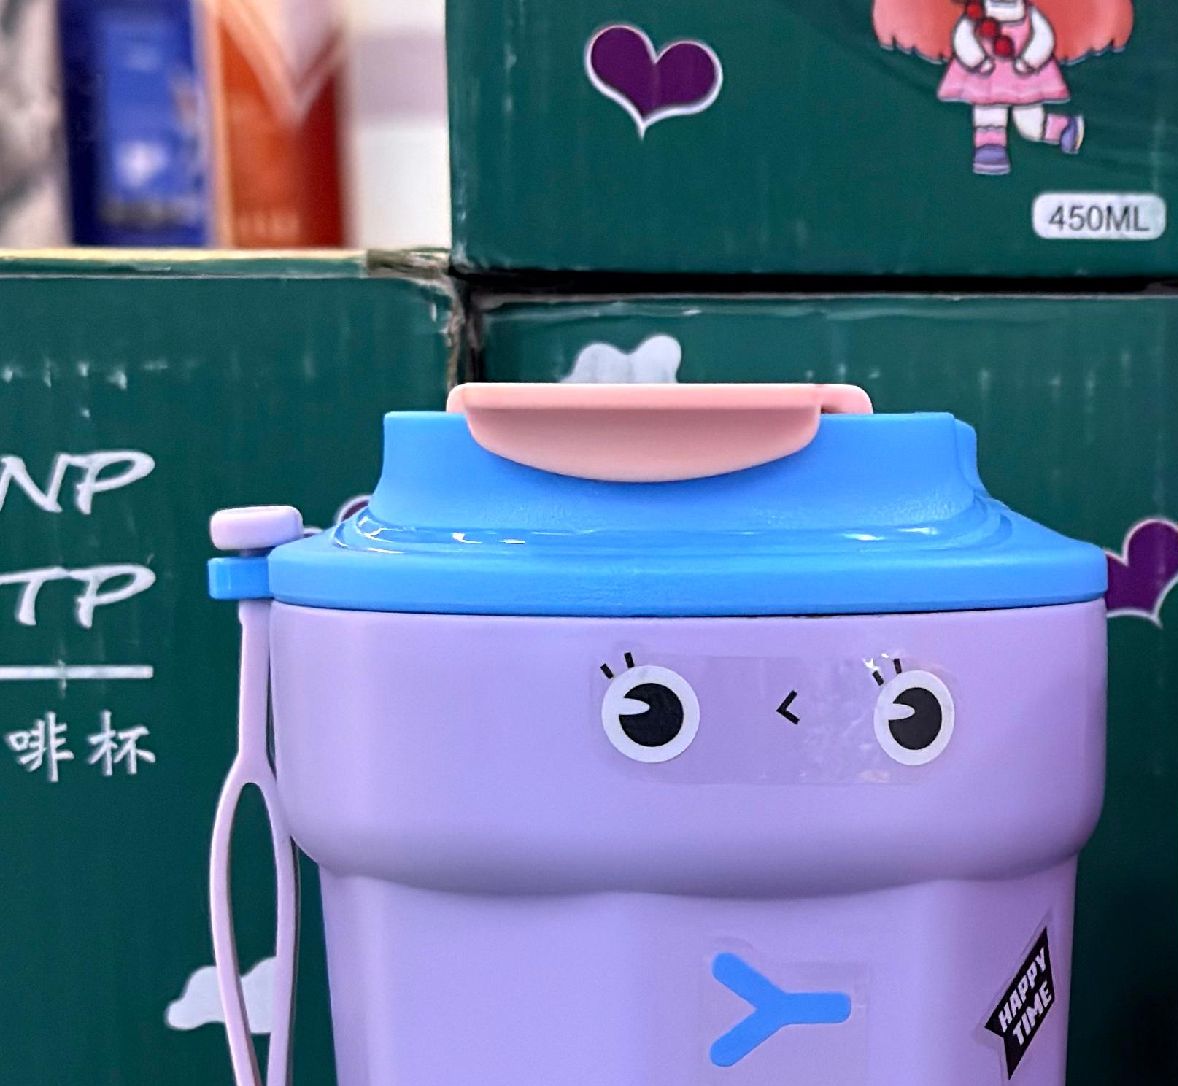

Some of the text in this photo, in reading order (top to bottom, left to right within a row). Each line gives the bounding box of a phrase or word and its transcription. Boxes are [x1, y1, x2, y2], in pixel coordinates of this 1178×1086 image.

[1048, 204, 1151, 232] 450ML
[4, 710, 156, 783] 啡杯
[998, 947, 1047, 1033] HAPPY
[1012, 980, 1052, 1046] TIME
